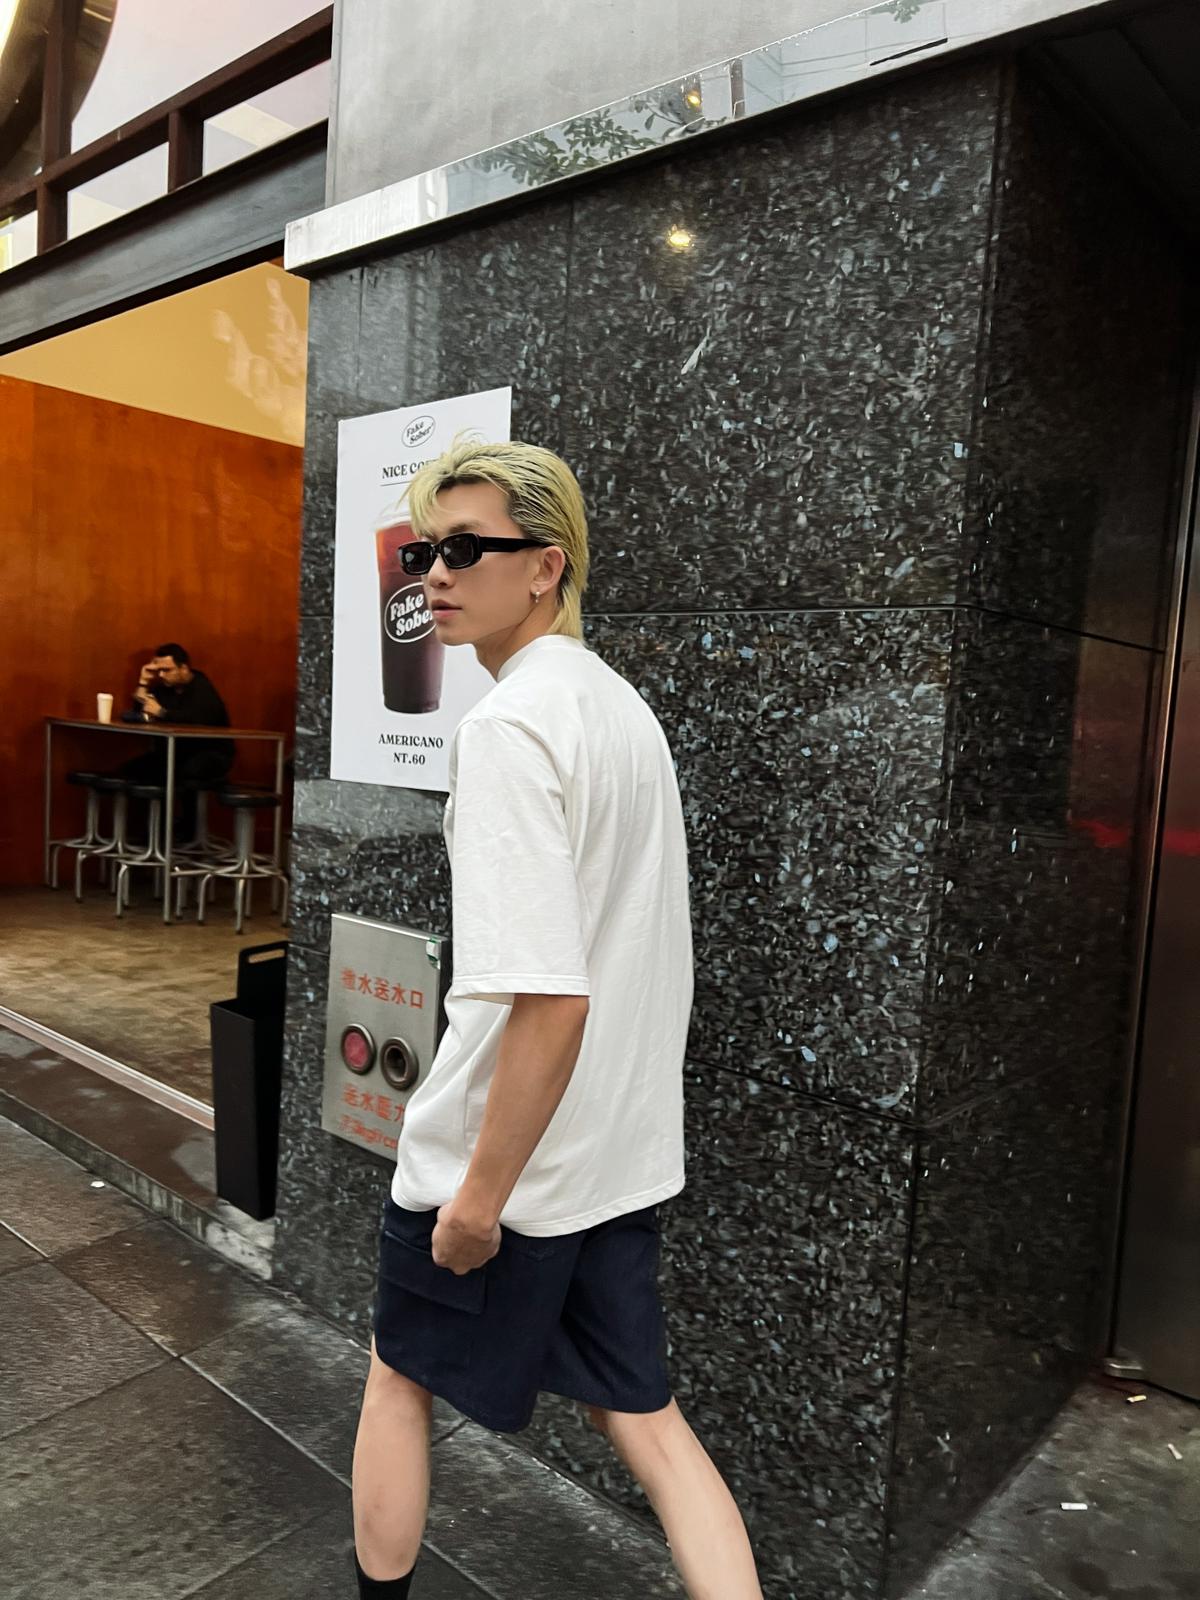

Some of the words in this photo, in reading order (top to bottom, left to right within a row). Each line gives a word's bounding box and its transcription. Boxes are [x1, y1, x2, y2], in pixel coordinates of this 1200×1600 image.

[406, 421, 425, 438] Fake
[409, 422, 434, 445] Sober
[382, 464, 408, 479] NICE
[390, 593, 424, 622] Fake
[378, 733, 444, 749] AMERICANO
[393, 752, 426, 765] NT.60
